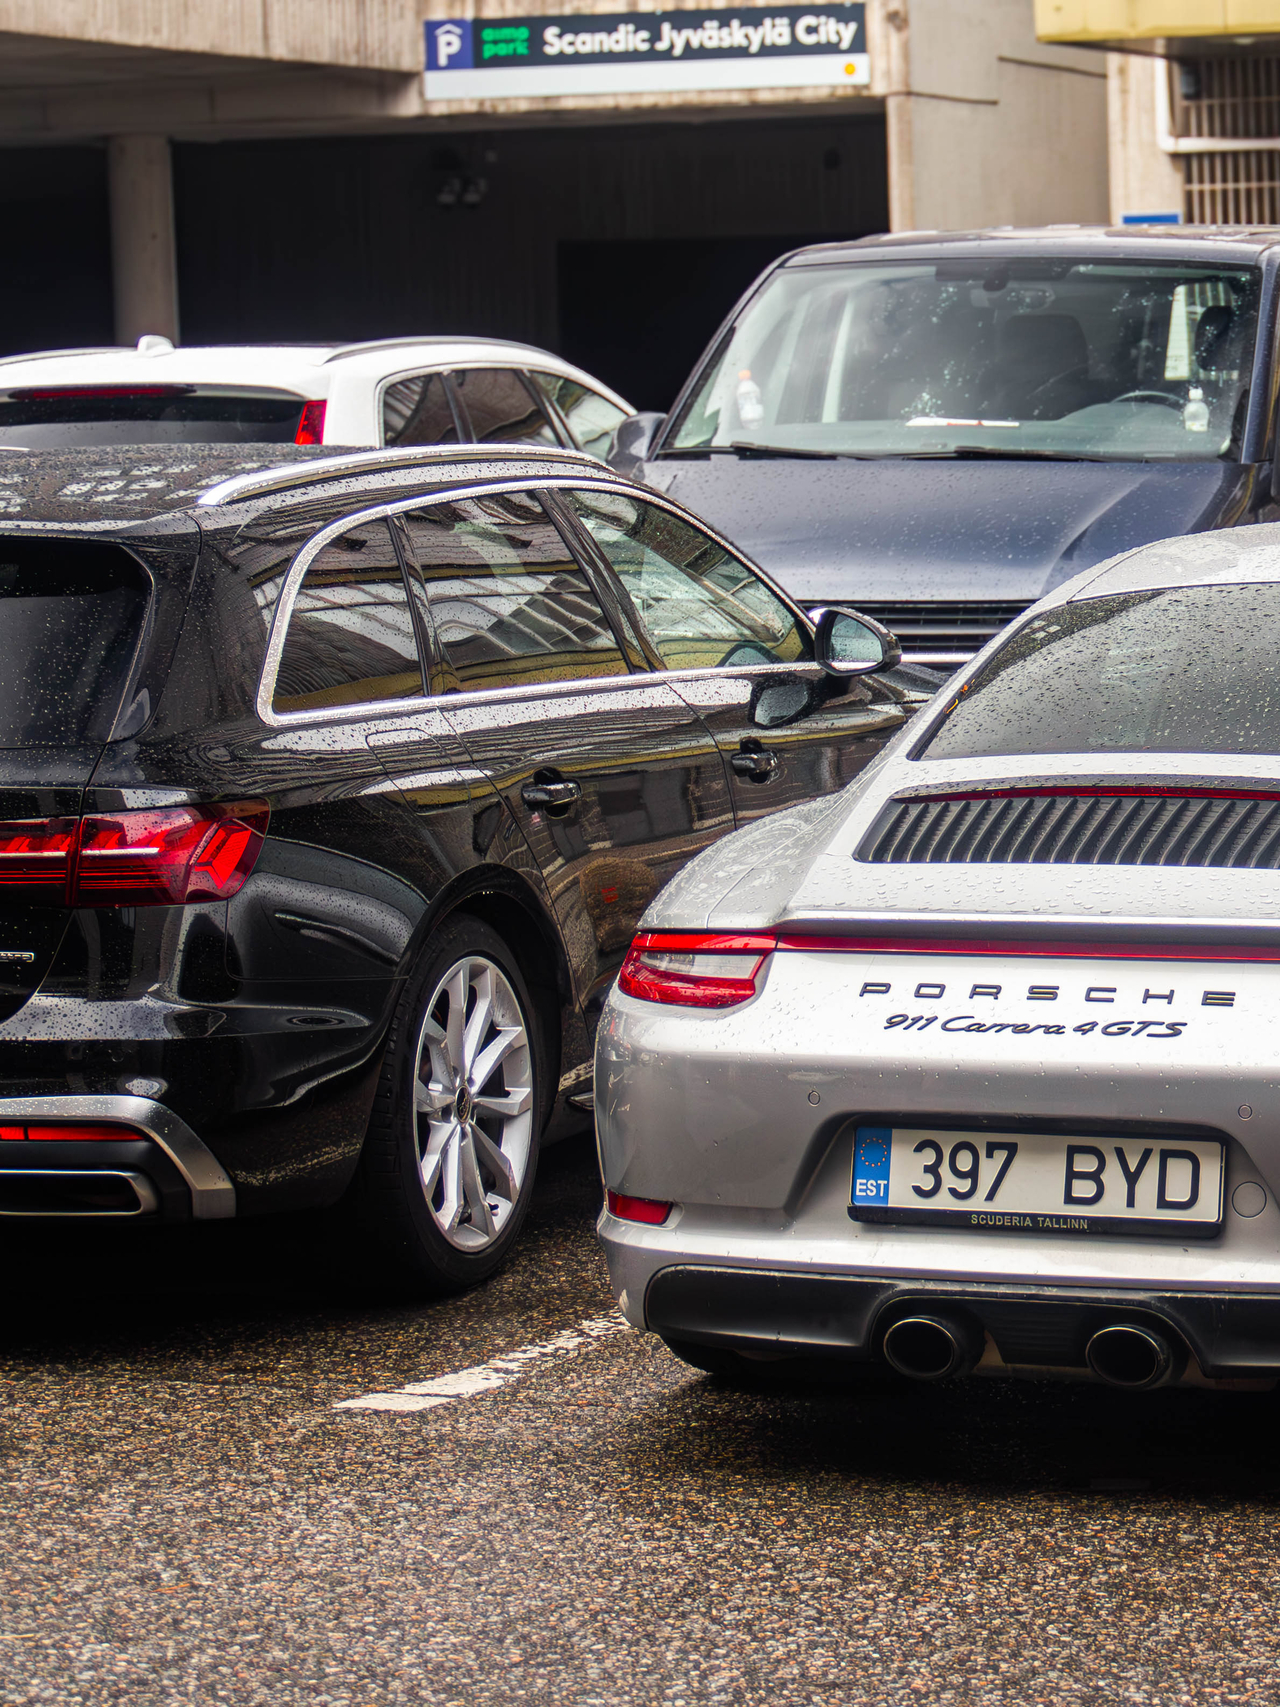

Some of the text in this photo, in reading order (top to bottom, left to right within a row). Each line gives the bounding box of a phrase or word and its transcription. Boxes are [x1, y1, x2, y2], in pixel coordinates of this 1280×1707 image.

[482, 26, 529, 41] aimo
[543, 16, 857, 56] Scandic Jyväskylä City
[436, 36, 462, 66] P
[482, 41, 529, 58] park
[859, 982, 1237, 1007] PORSCHE
[884, 1013, 1188, 1038] 911 Carrera 4 GTS
[911, 1138, 1201, 1210] 397 BYD
[855, 1179, 888, 1197] EST
[970, 1213, 1088, 1230] SCUDERIA TALLINN
